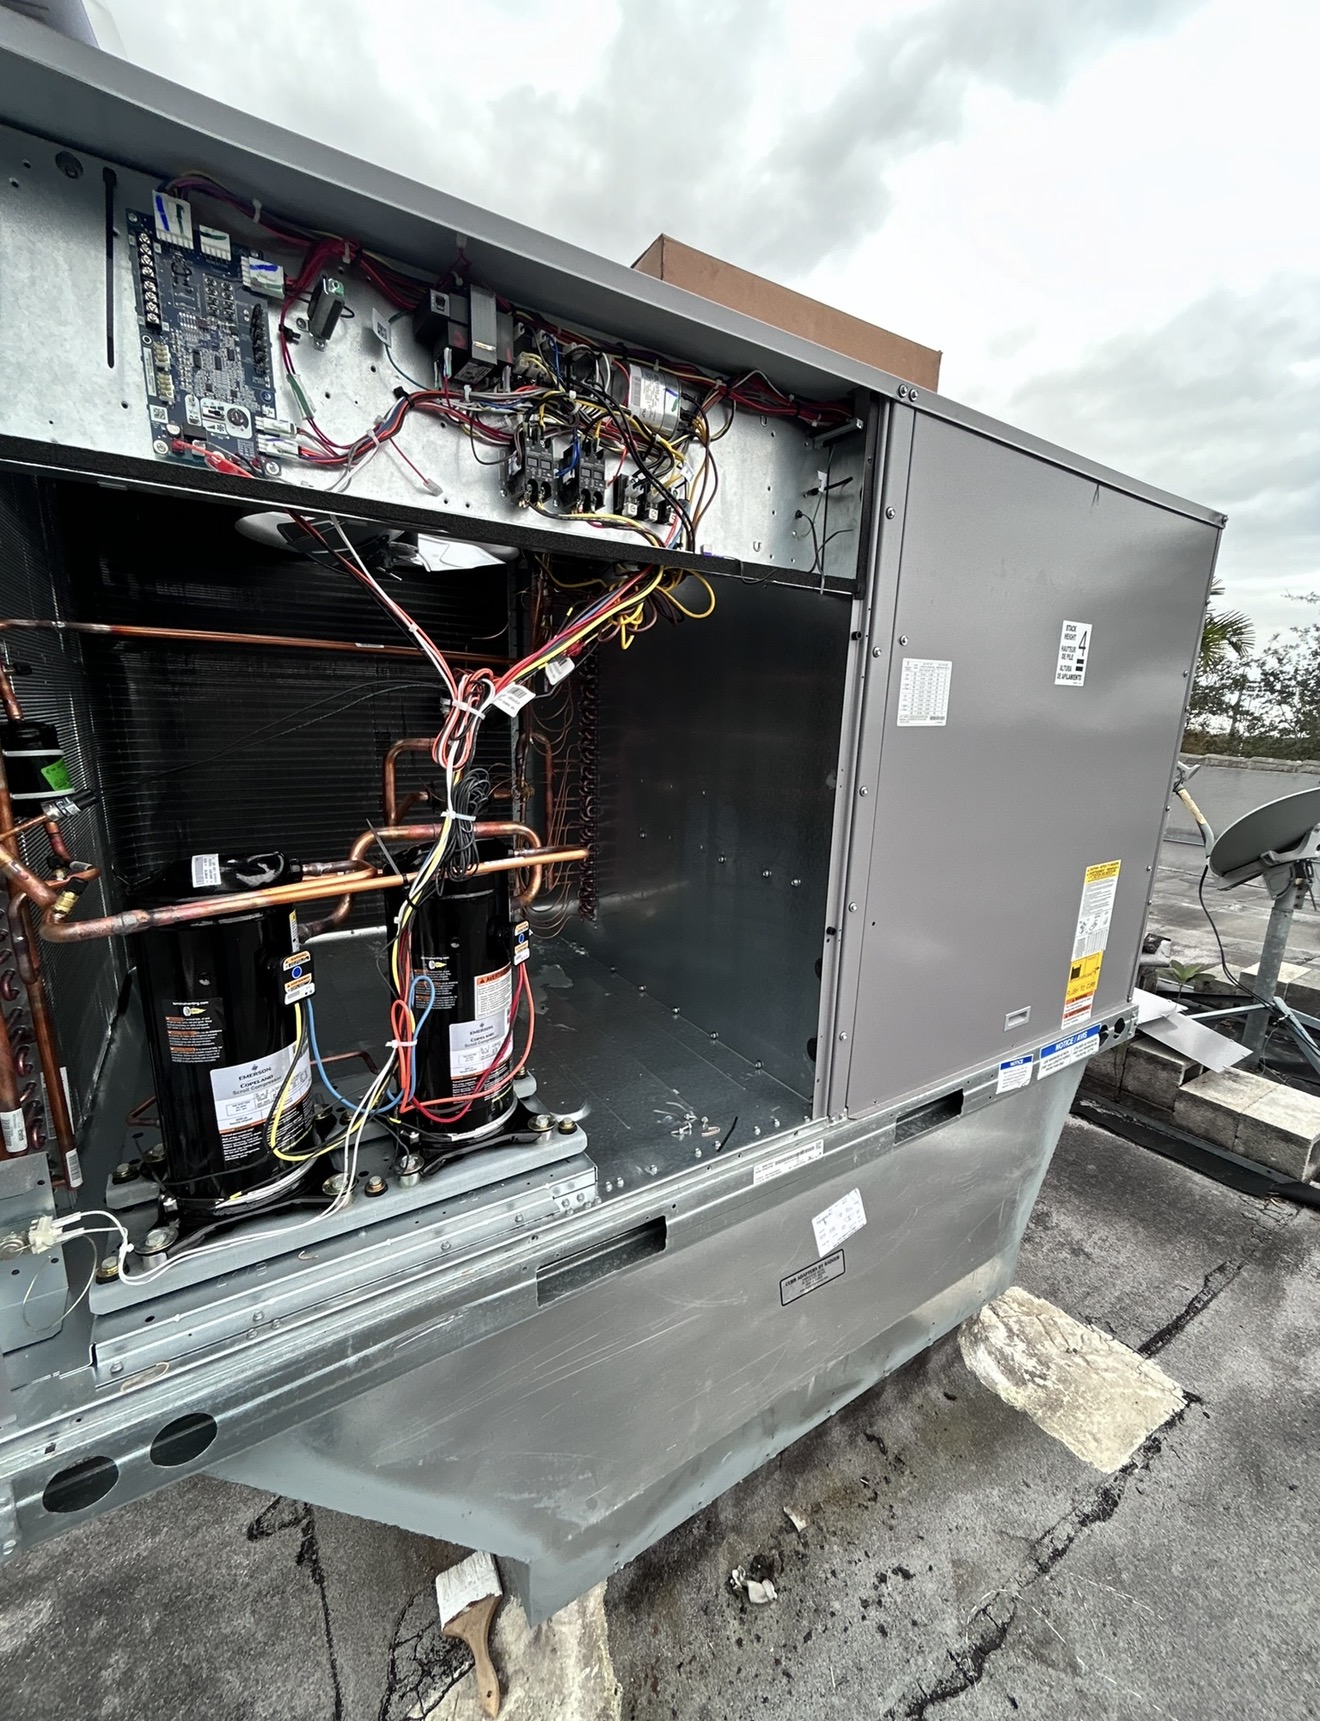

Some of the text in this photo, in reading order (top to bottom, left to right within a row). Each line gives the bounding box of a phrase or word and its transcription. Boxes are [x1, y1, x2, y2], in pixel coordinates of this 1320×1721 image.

[1078, 630, 1088, 657] 4
[469, 1025, 494, 1036] EMERSON
[1055, 1037, 1074, 1051] NOTICE
[1077, 1031, 1088, 1042] AVIS
[1009, 1058, 1024, 1067] NOTICE
[238, 1066, 272, 1081] EMERSON
[232, 1087, 251, 1096] Scroll
